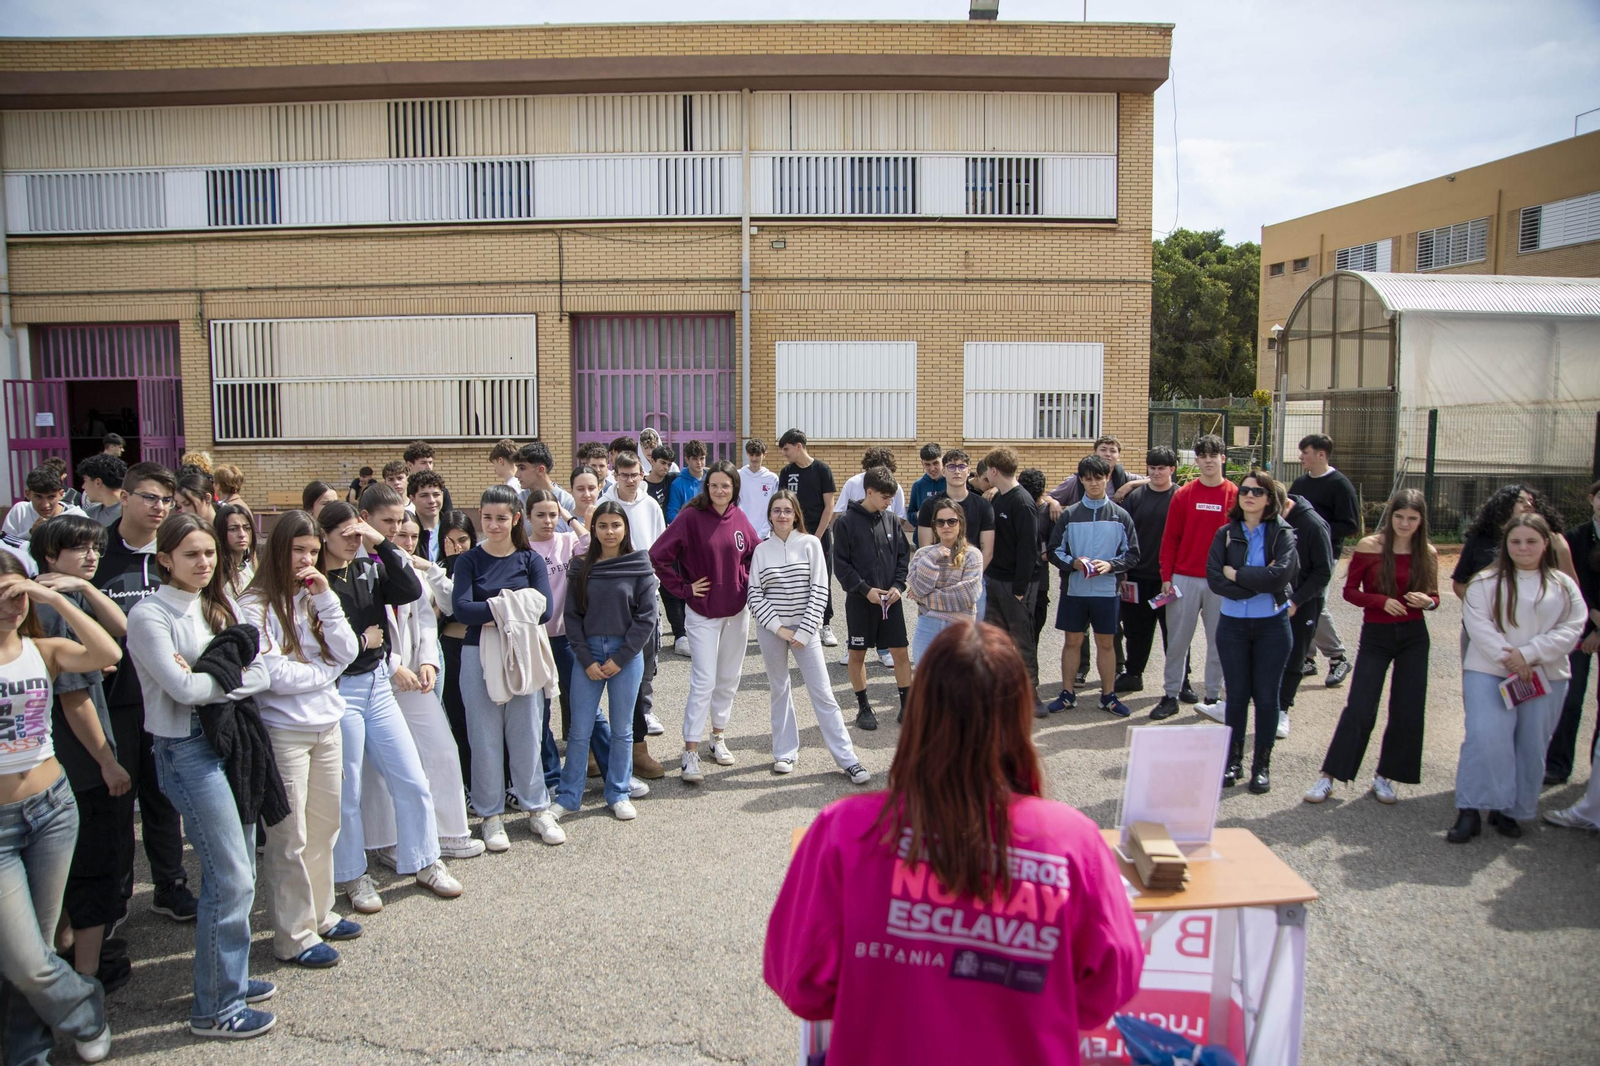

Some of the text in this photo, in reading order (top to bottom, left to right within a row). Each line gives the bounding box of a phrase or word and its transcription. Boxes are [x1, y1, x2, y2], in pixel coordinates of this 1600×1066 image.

[734, 531, 744, 551] C
[15, 714, 27, 739] RAP
[887, 898, 1061, 951] ESCLAVAS
[854, 941, 946, 968] BETANIA
